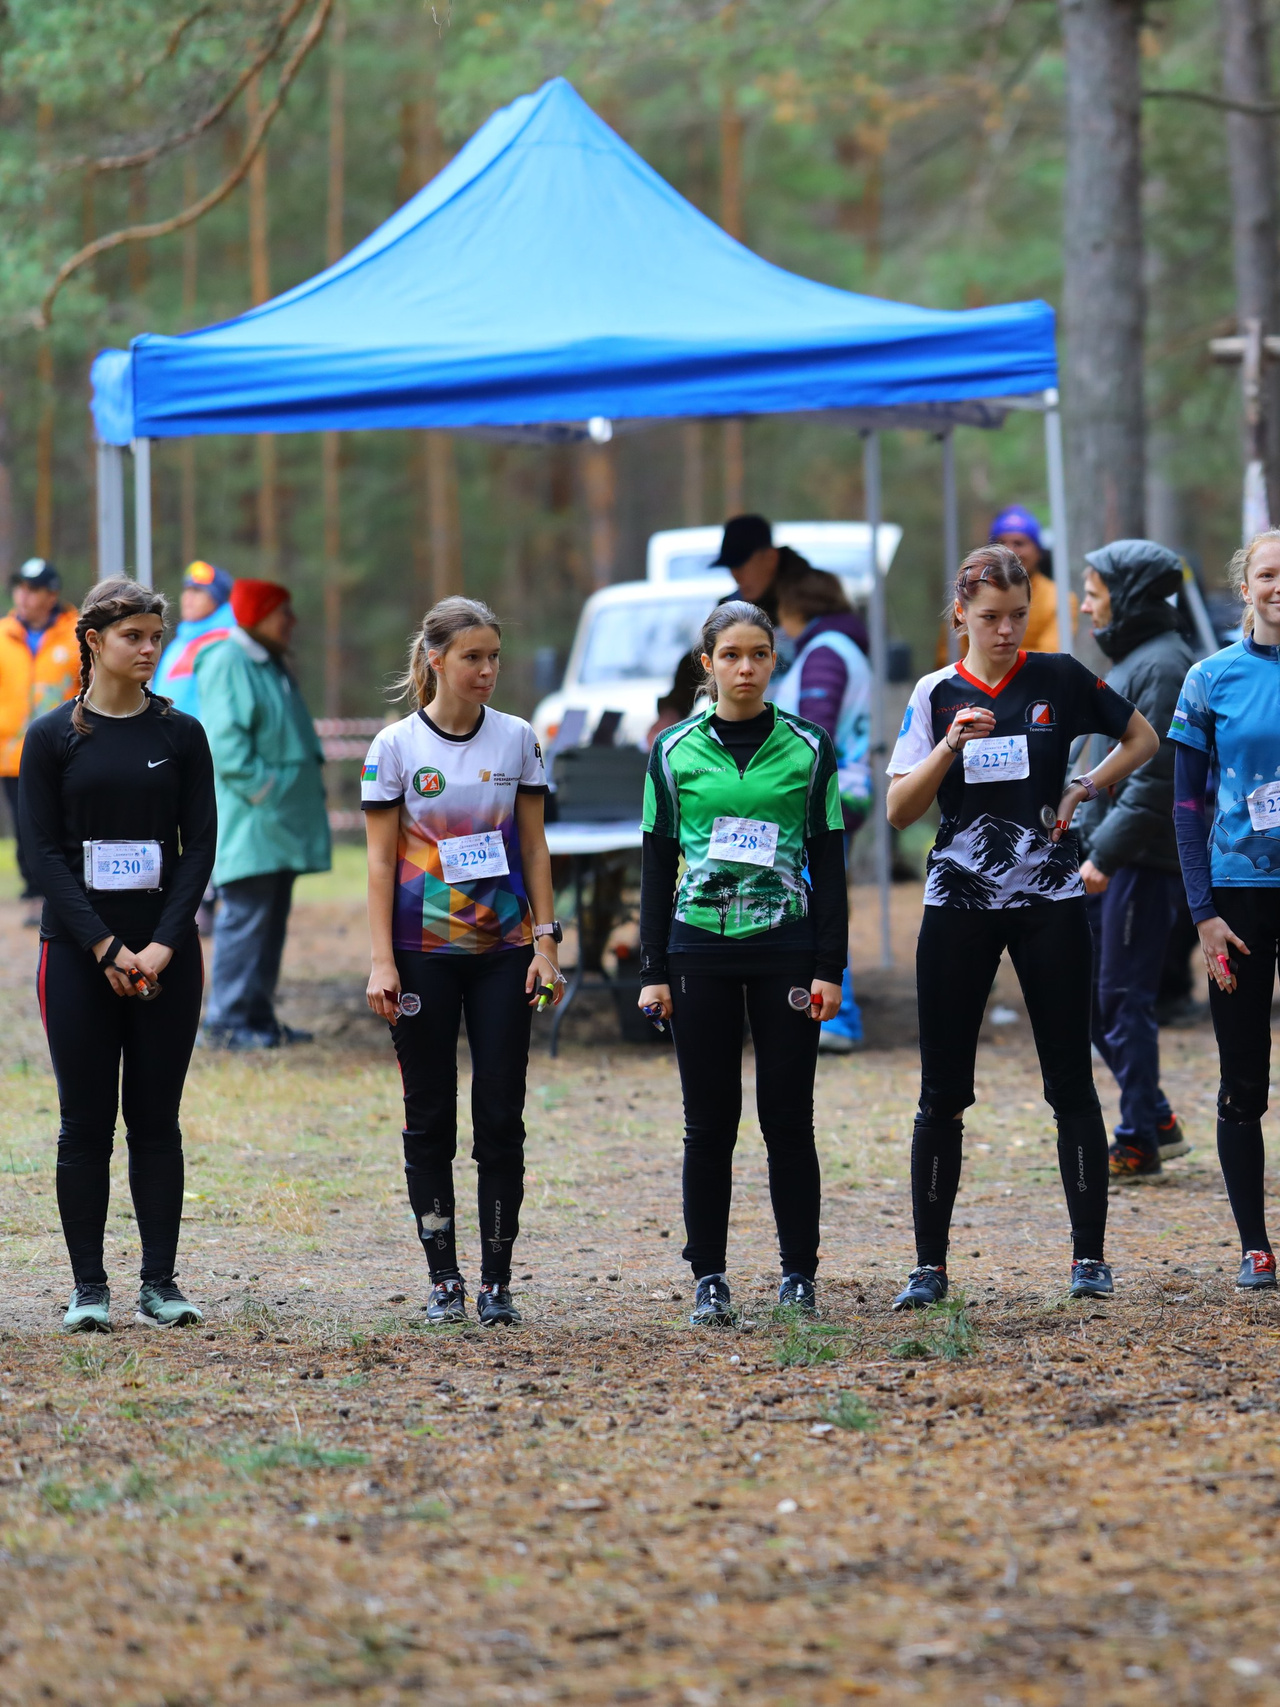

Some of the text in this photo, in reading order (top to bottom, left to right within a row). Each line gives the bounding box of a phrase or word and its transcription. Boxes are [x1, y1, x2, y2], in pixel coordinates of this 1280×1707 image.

[981, 752, 1009, 767] 227
[730, 833, 757, 850] 228
[460, 850, 487, 866] 229
[111, 860, 141, 875] 230
